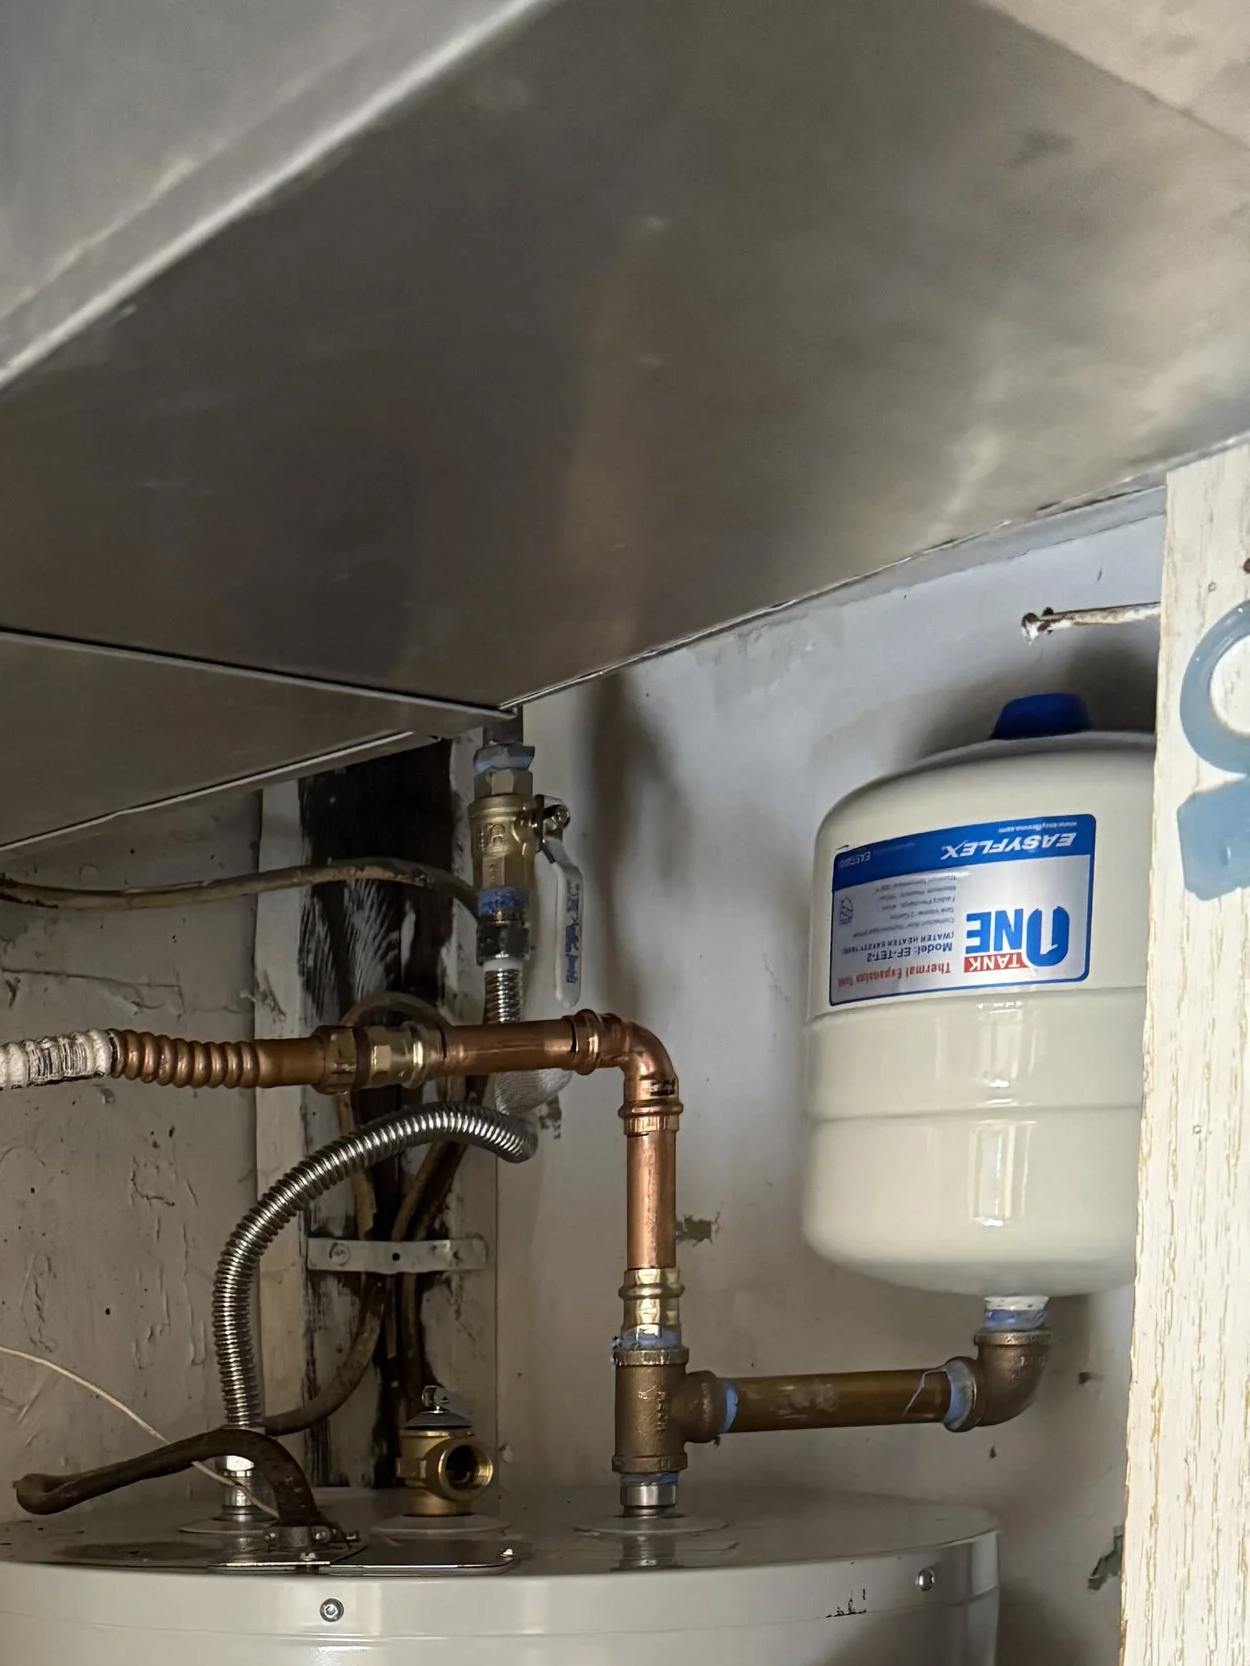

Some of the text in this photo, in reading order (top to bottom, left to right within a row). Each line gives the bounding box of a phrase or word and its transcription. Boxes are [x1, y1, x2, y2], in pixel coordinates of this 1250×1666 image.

[940, 832, 1078, 860] EASYFLEX
[867, 942, 953, 962] Model: EF-TET-2
[906, 962, 951, 976] Thermal
[968, 954, 1021, 971] TANK
[855, 967, 902, 984] Expansion
